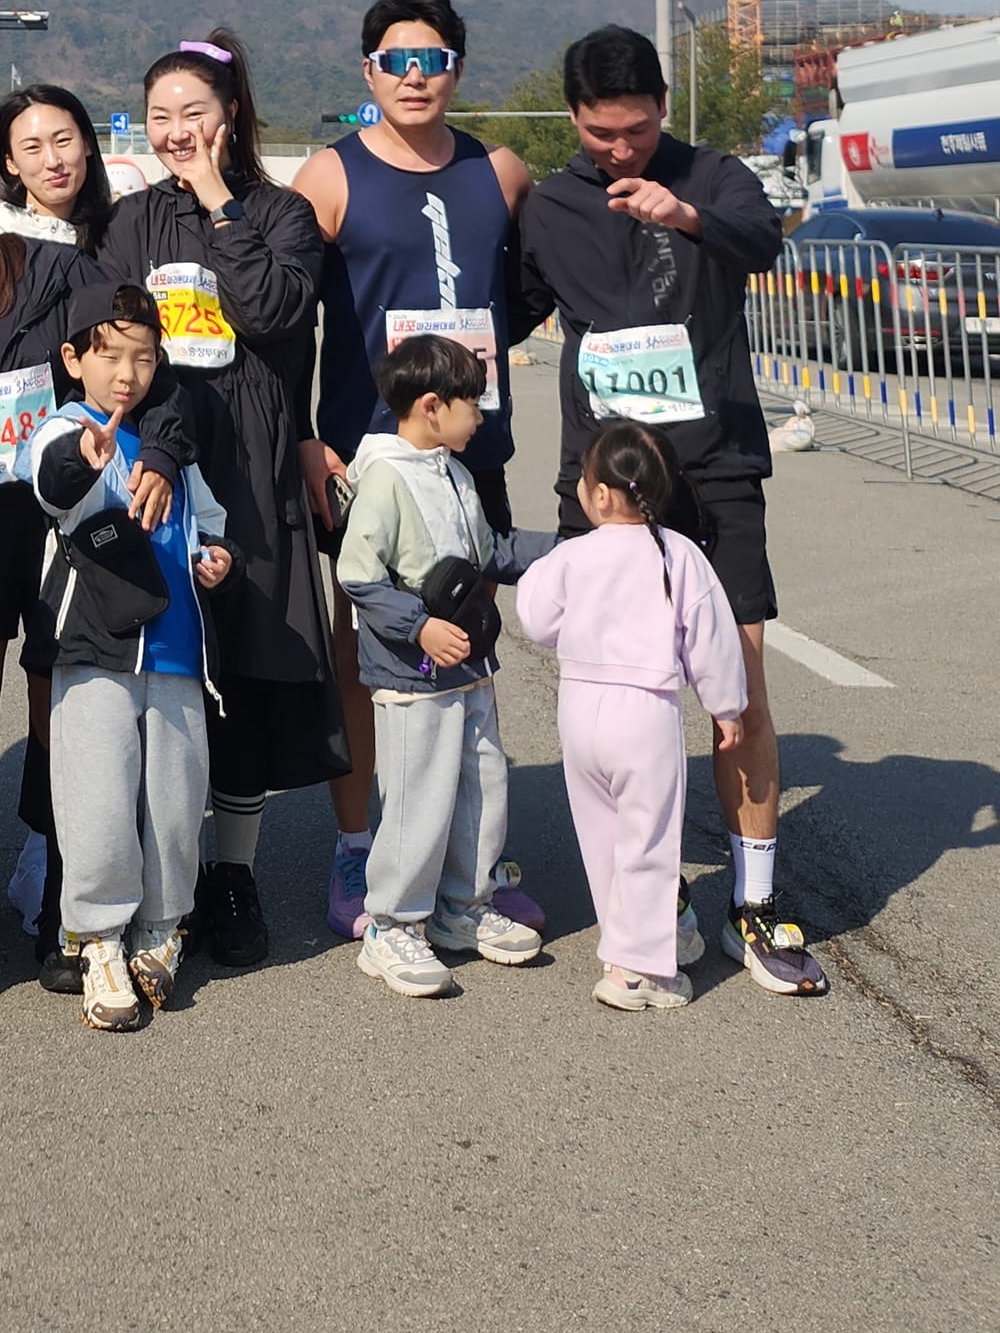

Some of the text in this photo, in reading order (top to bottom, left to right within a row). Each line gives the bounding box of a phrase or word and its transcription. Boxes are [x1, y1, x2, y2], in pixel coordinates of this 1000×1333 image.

[158, 302, 223, 335] 6725
[393, 320, 456, 332] 내포마라톤대회
[584, 366, 688, 397] 11001
